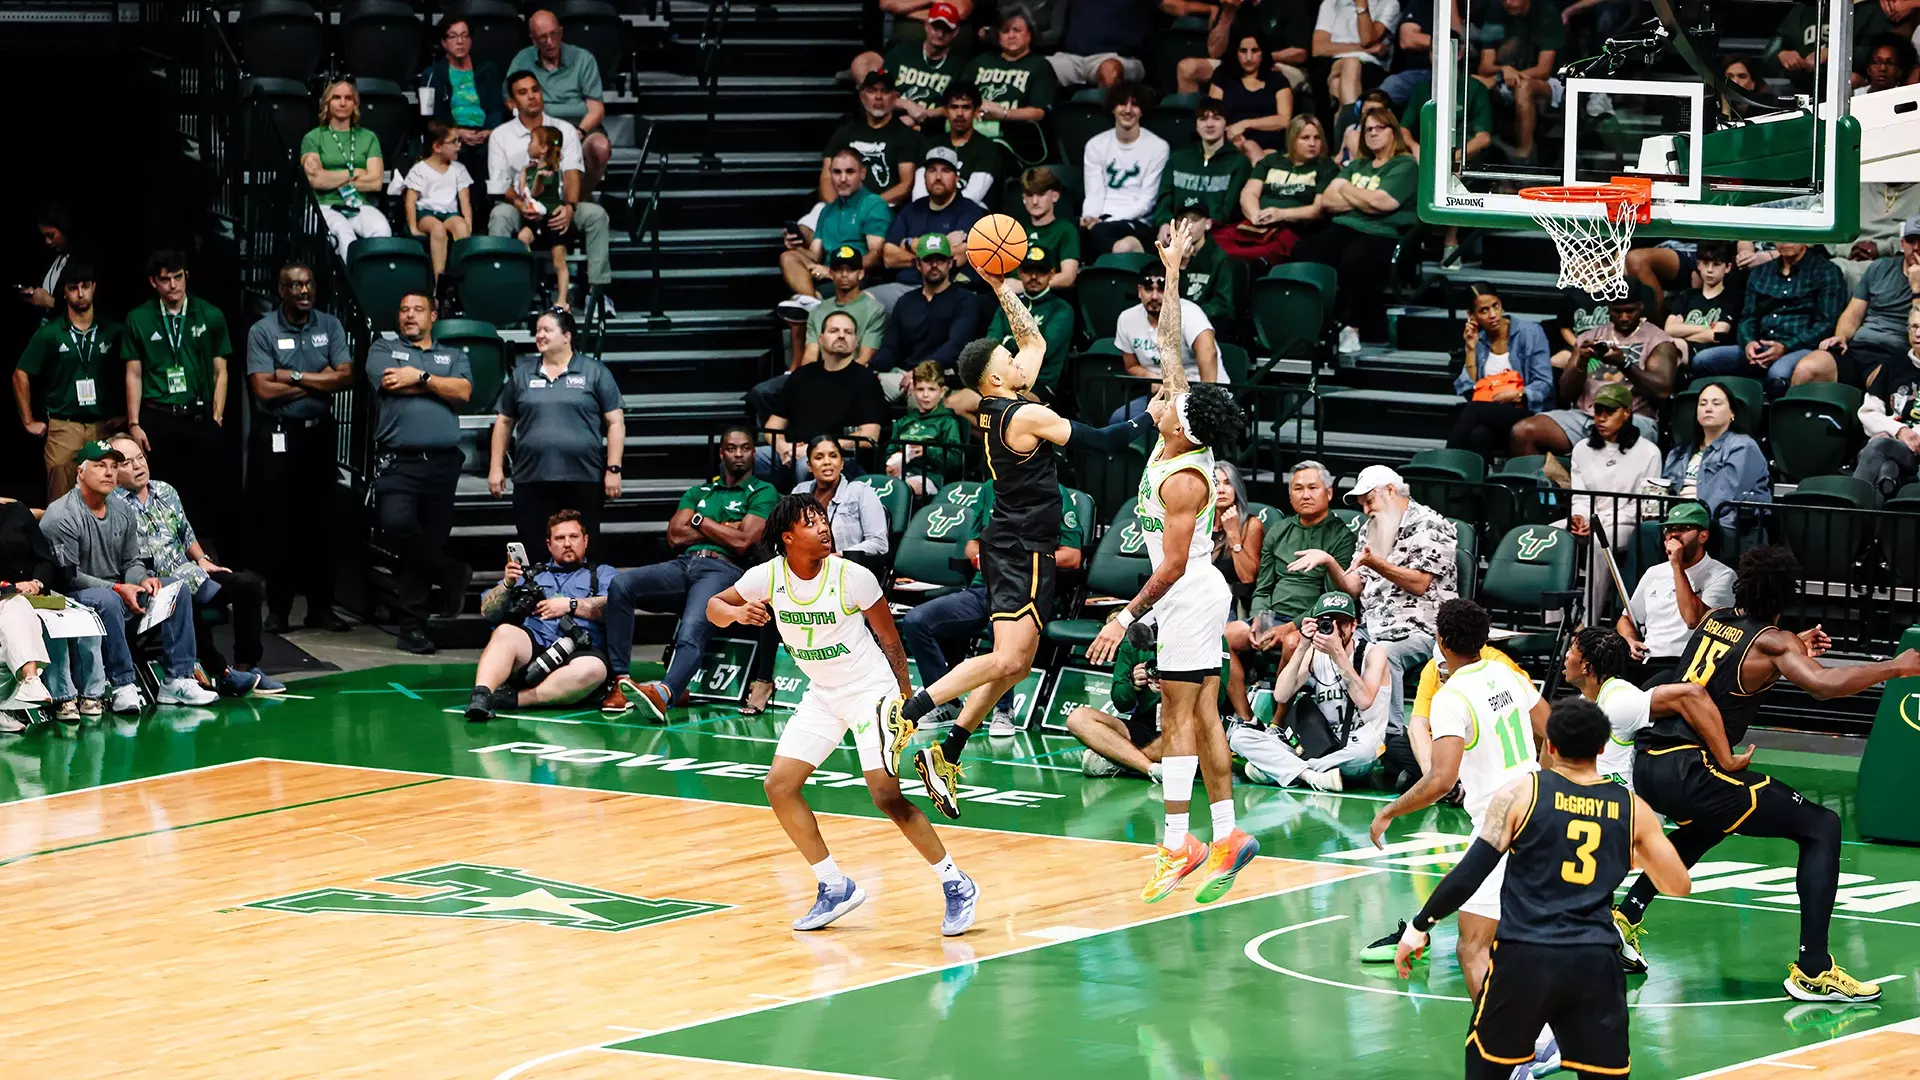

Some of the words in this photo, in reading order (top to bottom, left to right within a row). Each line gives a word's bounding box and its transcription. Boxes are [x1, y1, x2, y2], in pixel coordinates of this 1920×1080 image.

[1446, 196, 1484, 208] SPALDING
[985, 431, 997, 480] 1
[779, 610, 836, 625] SOUTH
[801, 626, 814, 647] 7
[1703, 618, 1744, 643] BALLARD
[1681, 634, 1731, 687] 15
[709, 664, 742, 690] 57
[774, 675, 803, 693] SEAT
[1488, 689, 1514, 712] BROWN
[1495, 707, 1530, 769] 11
[1607, 800, 1619, 820] III
[1560, 819, 1602, 885] 3
